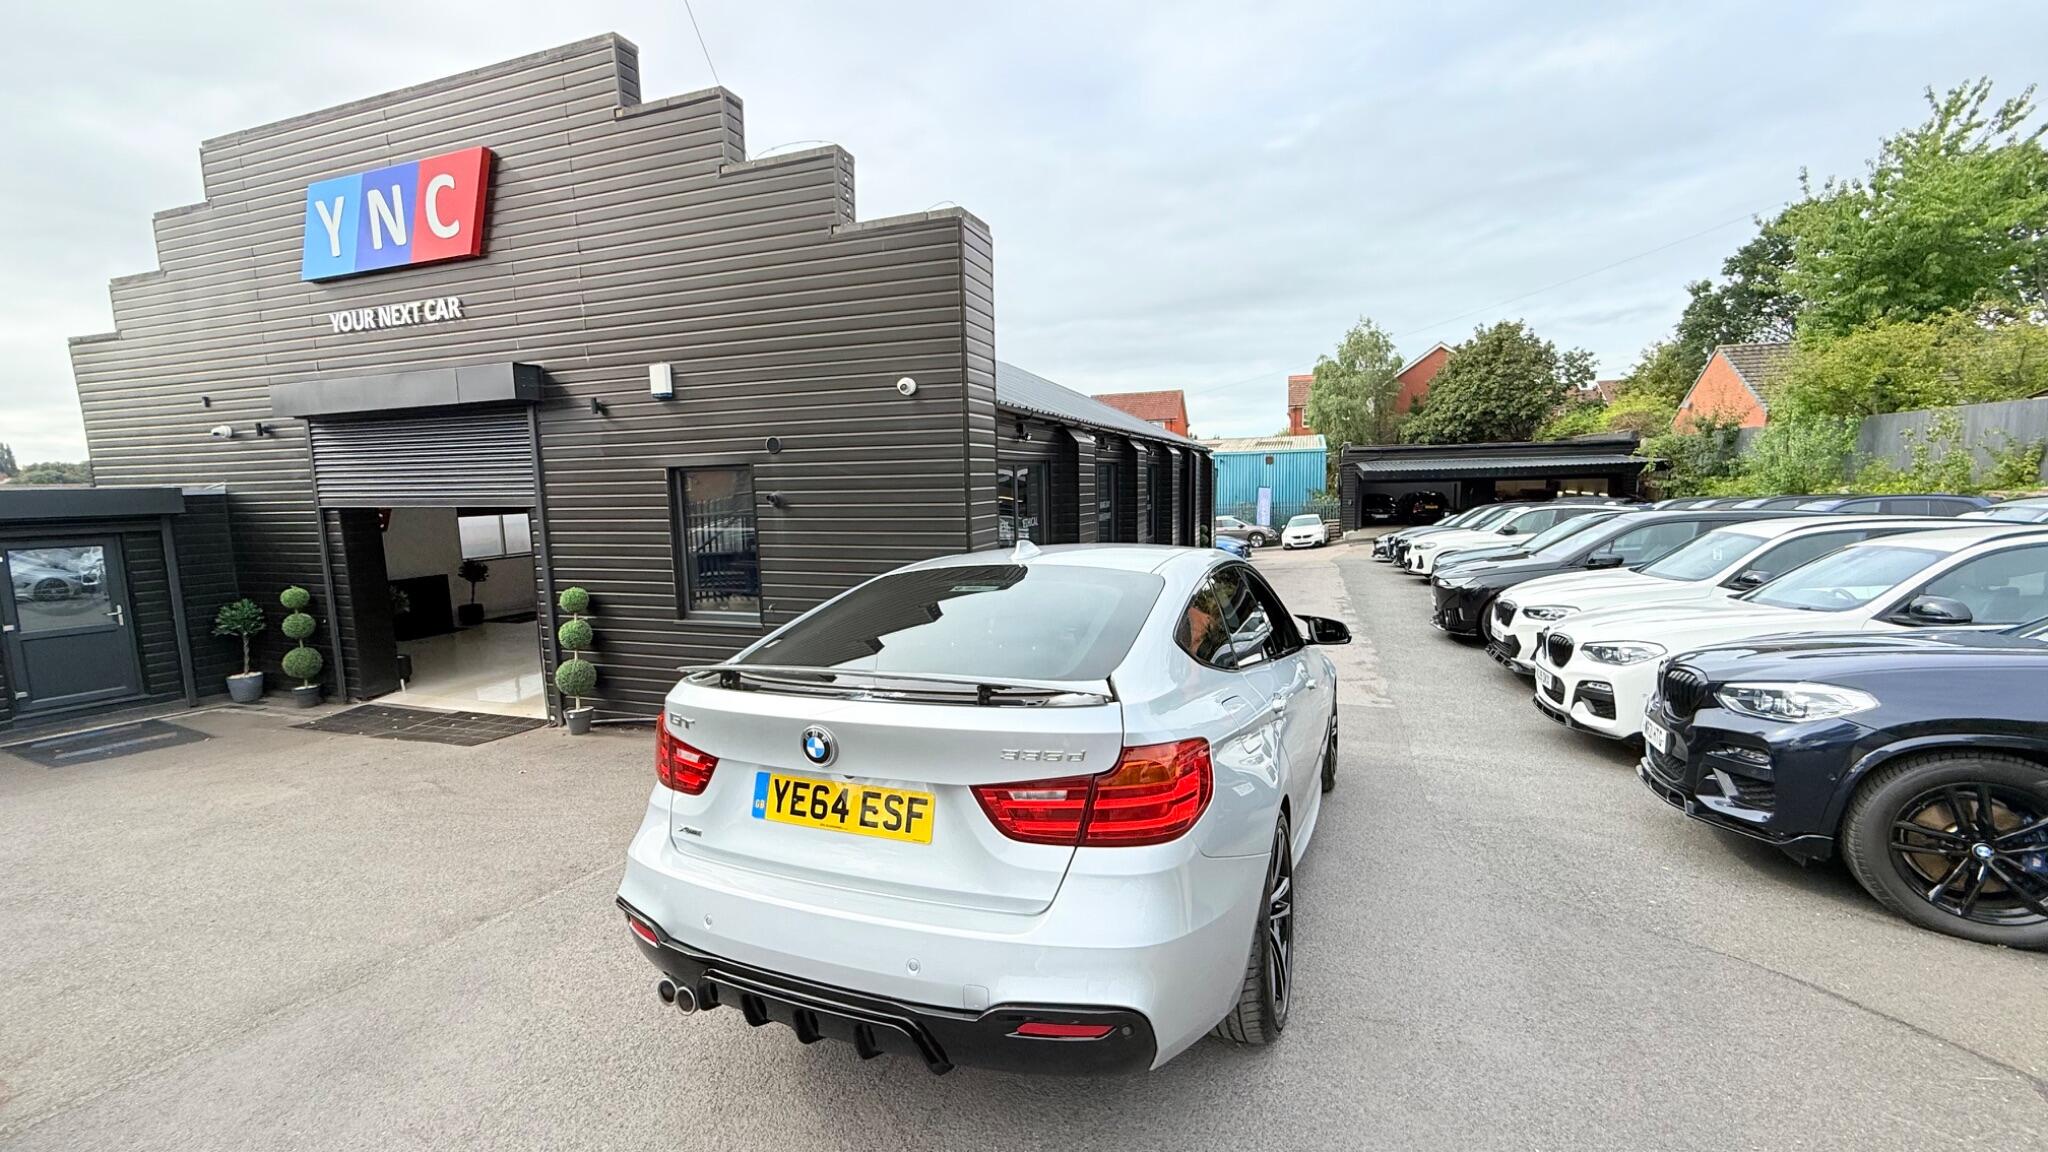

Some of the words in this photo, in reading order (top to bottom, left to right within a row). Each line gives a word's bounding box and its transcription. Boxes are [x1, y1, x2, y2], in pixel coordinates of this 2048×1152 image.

[315, 173, 460, 257] YNC
[329, 309, 376, 333] YOUR
[378, 301, 421, 327] NEXT
[424, 296, 462, 321] CAR
[1000, 748, 1086, 762] 335d
[774, 778, 849, 823] YE64
[859, 790, 928, 833] ESF
